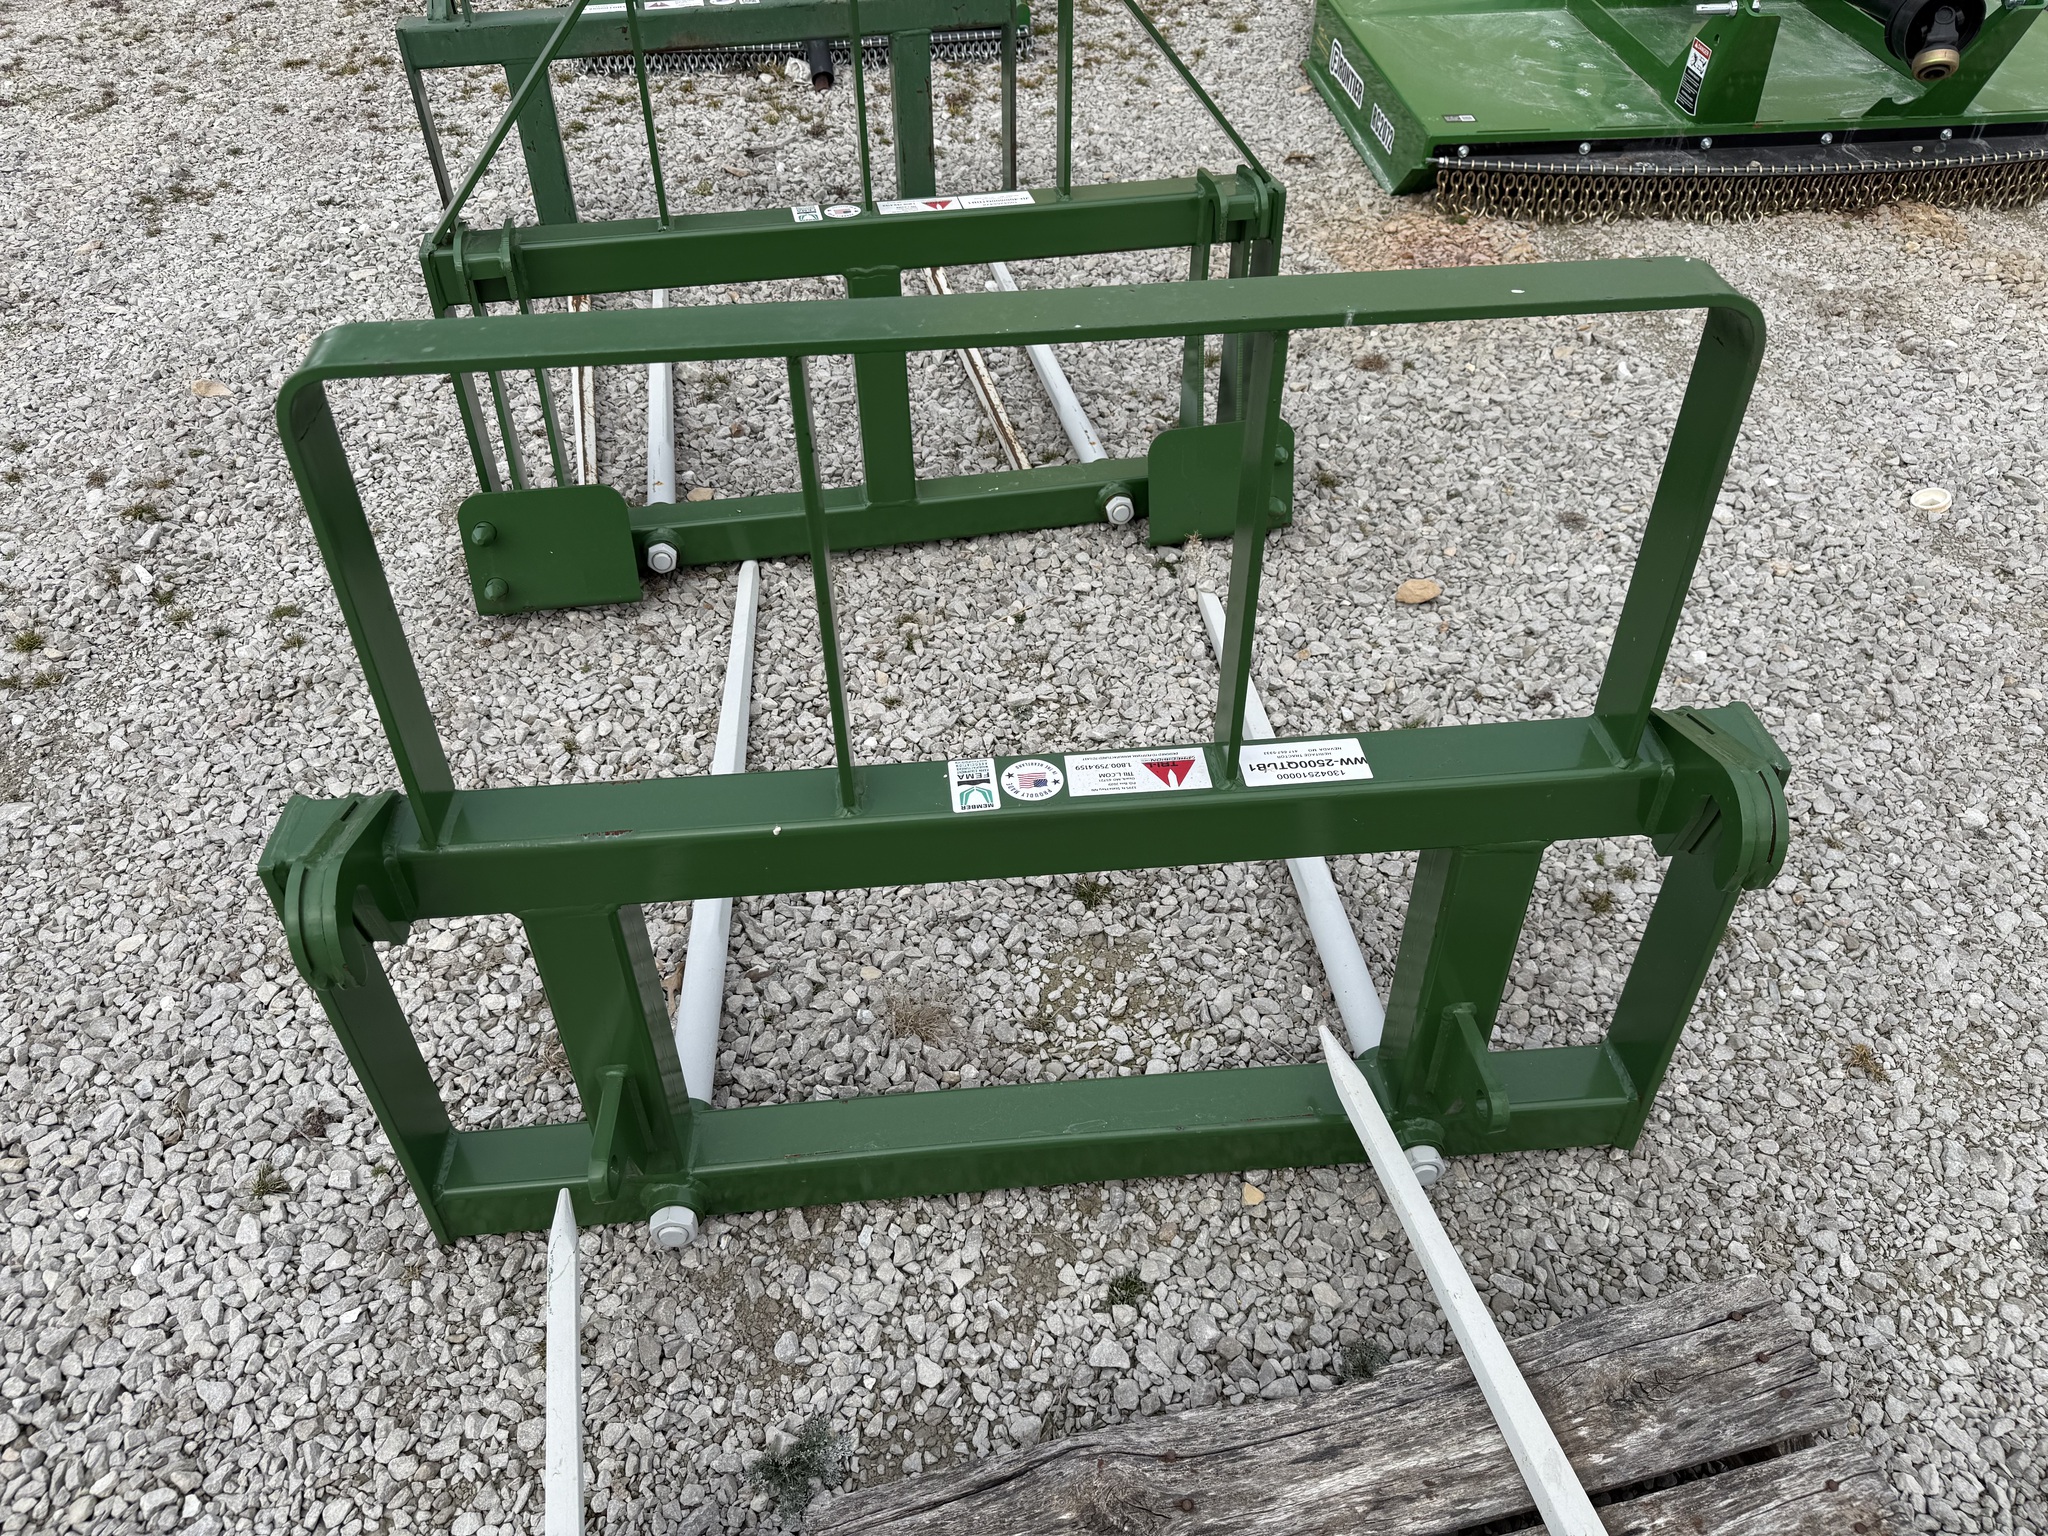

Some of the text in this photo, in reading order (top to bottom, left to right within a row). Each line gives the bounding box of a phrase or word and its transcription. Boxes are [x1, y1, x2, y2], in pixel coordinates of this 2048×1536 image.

[1330, 39, 1363, 109] FRONTIER
[1371, 104, 1394, 154] RC2072
[1277, 770, 1345, 780] 13042510000
[1021, 789, 1052, 798] PROUDLY
